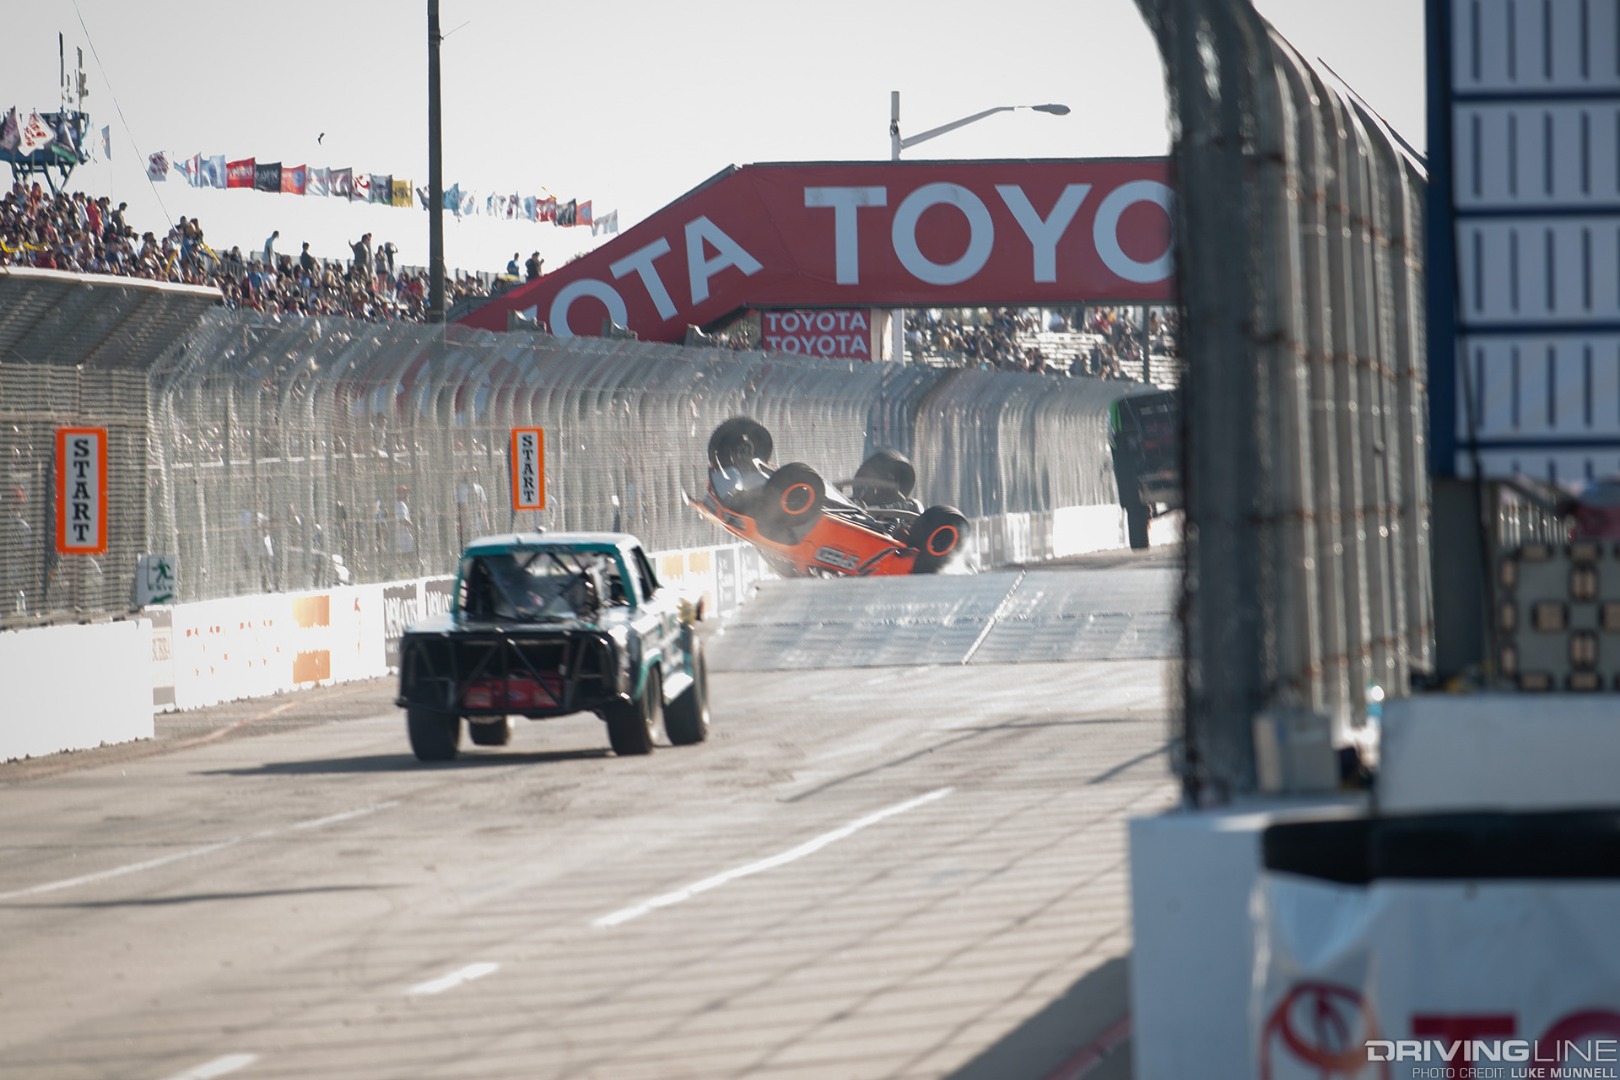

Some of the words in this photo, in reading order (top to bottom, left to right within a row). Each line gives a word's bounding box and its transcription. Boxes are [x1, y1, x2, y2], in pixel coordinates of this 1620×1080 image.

[804, 180, 1176, 286] TOYO
[523, 215, 764, 338] OTA
[765, 311, 868, 333] TOYOTA
[765, 334, 869, 355] TOYOTA
[72, 438, 91, 542] START
[522, 434, 535, 503] START
